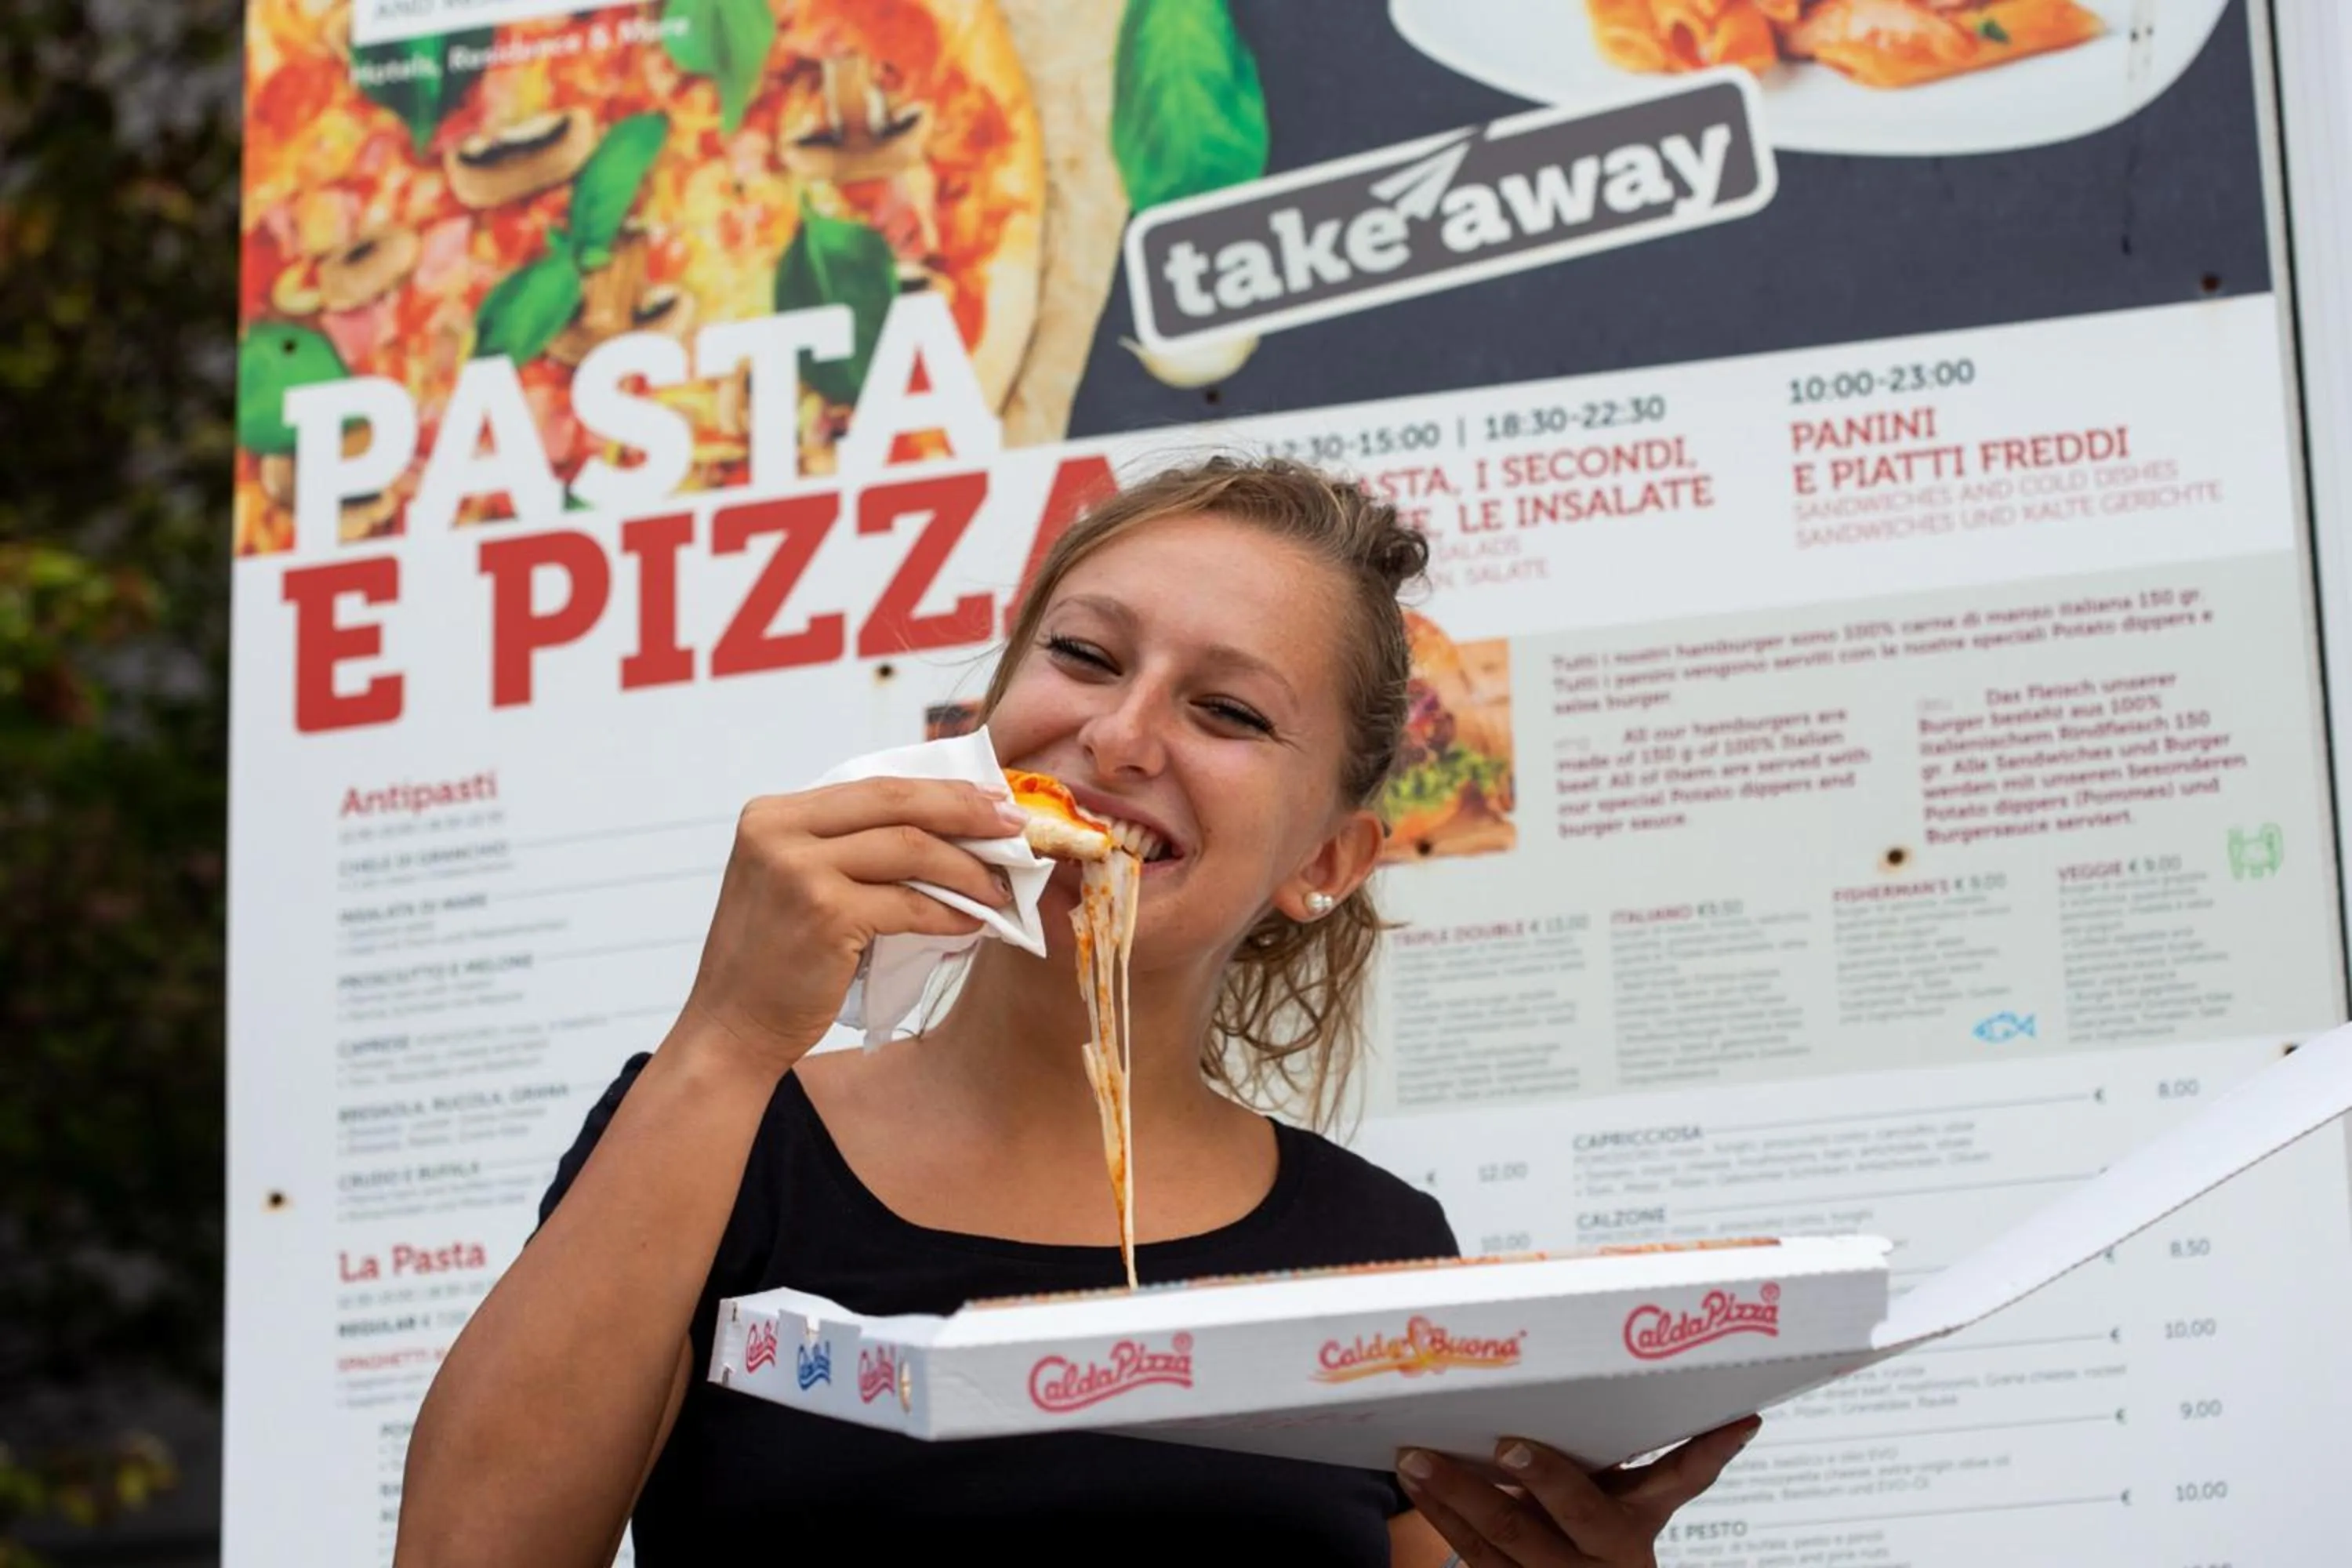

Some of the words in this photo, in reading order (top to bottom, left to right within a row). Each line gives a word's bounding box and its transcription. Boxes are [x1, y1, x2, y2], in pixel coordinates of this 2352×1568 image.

[1164, 205, 1410, 317] take
[1442, 123, 1730, 252] away
[1788, 358, 1976, 405] 10:00-23:00
[282, 292, 1002, 554] PASTA
[1486, 395, 1666, 441] 18:30-22:30
[1791, 407, 1936, 452] PANINI
[1357, 465, 1461, 502] ASTA,
[1475, 458, 1488, 492] I
[1792, 463, 1817, 495] E
[1830, 445, 1966, 491] PIATTI
[1979, 426, 2129, 472] FREDDI
[1458, 499, 1504, 535] LE
[1517, 475, 1715, 528] INSALATE
[282, 555, 405, 735] E
[339, 769, 498, 819] Antipasti
[339, 1250, 380, 1283] La
[392, 1242, 486, 1276] Pasta
[1686, 1520, 1748, 1543] PESTO
